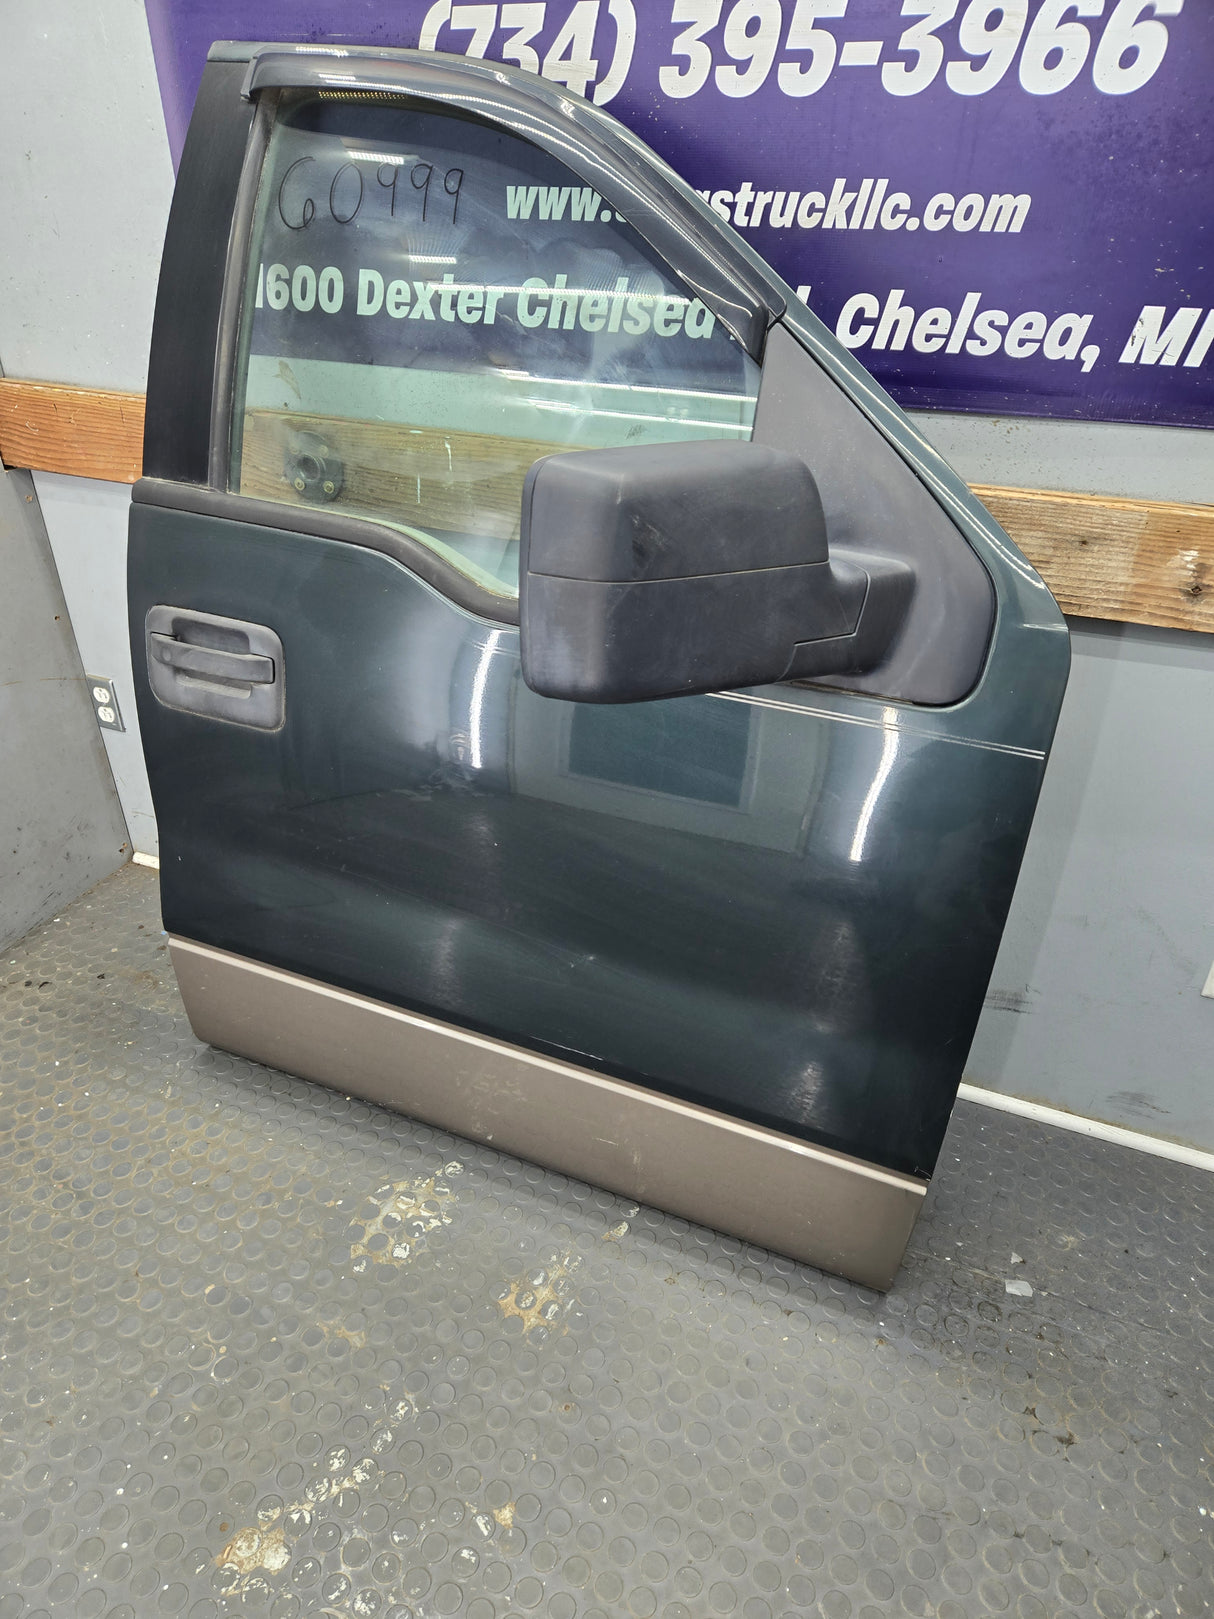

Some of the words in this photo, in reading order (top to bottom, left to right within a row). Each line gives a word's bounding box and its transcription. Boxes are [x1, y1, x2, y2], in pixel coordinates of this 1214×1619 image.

[658, 0, 1183, 98] 395-3966
[279, 156, 464, 230] 60999
[356, 269, 504, 325] Dexter
[515, 274, 716, 340] Chelsea
[835, 289, 1101, 373] Chelsea,
